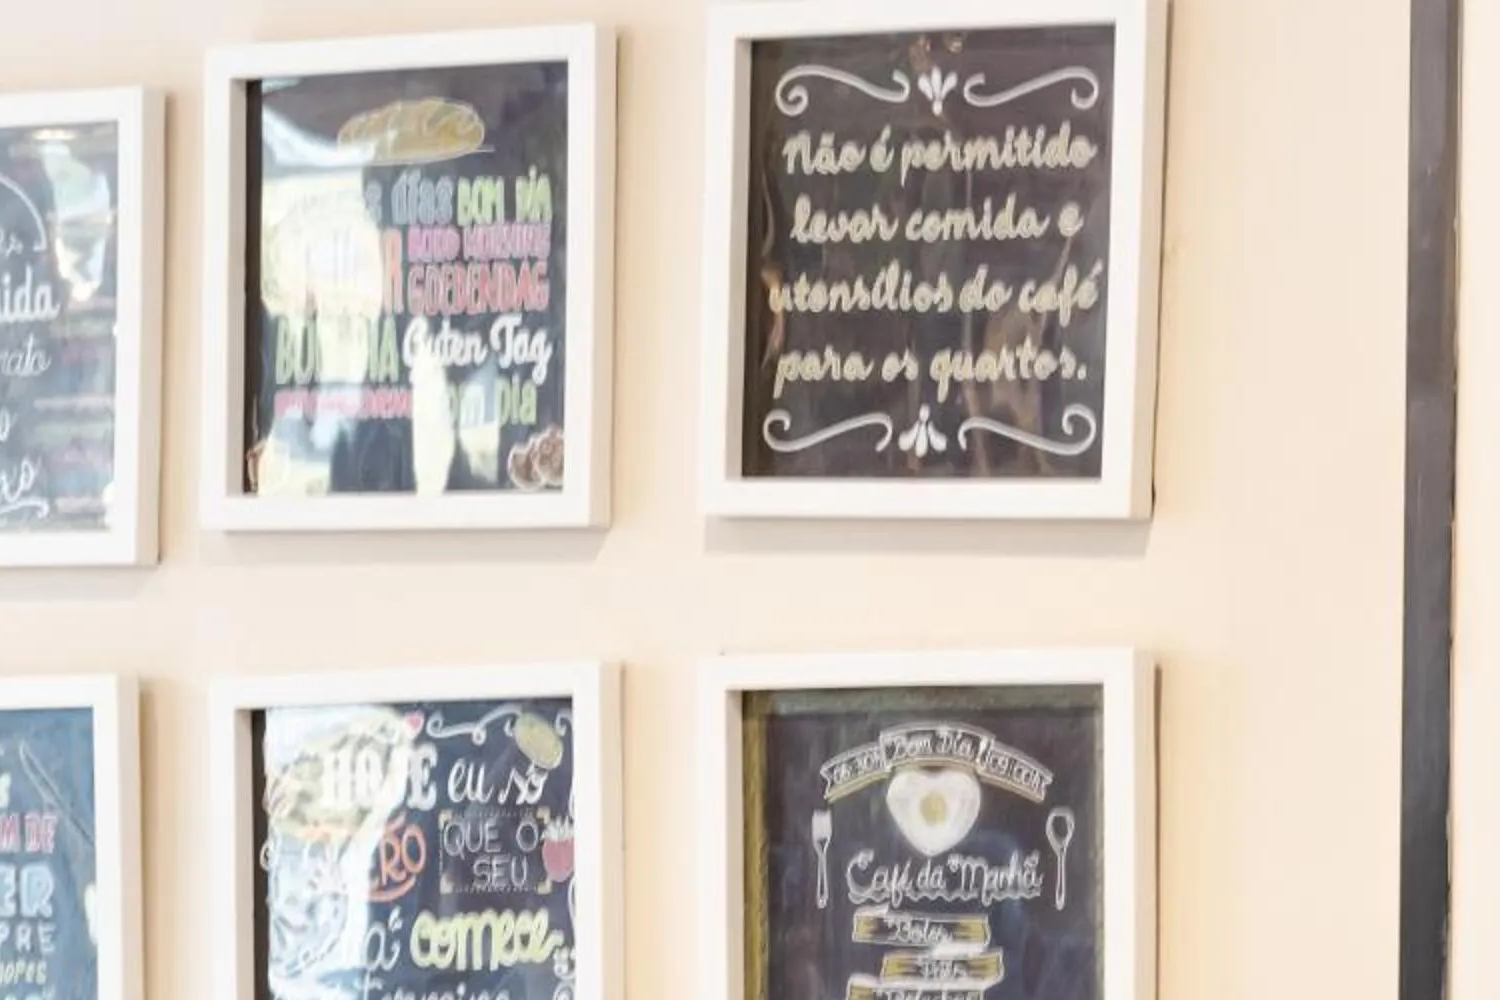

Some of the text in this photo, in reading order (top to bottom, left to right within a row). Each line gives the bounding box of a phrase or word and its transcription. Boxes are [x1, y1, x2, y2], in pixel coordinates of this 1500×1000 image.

[782, 129, 866, 175] Não
[900, 120, 1098, 188] permitido
[790, 191, 1085, 243] levar comida e
[959, 263, 1013, 313] do
[1018, 259, 1104, 328] café
[490, 313, 552, 385] Tag
[773, 345, 875, 399] para
[881, 349, 919, 383] os
[448, 758, 494, 804] eu
[444, 816, 501, 861] QUE
[472, 854, 528, 888] SEU
